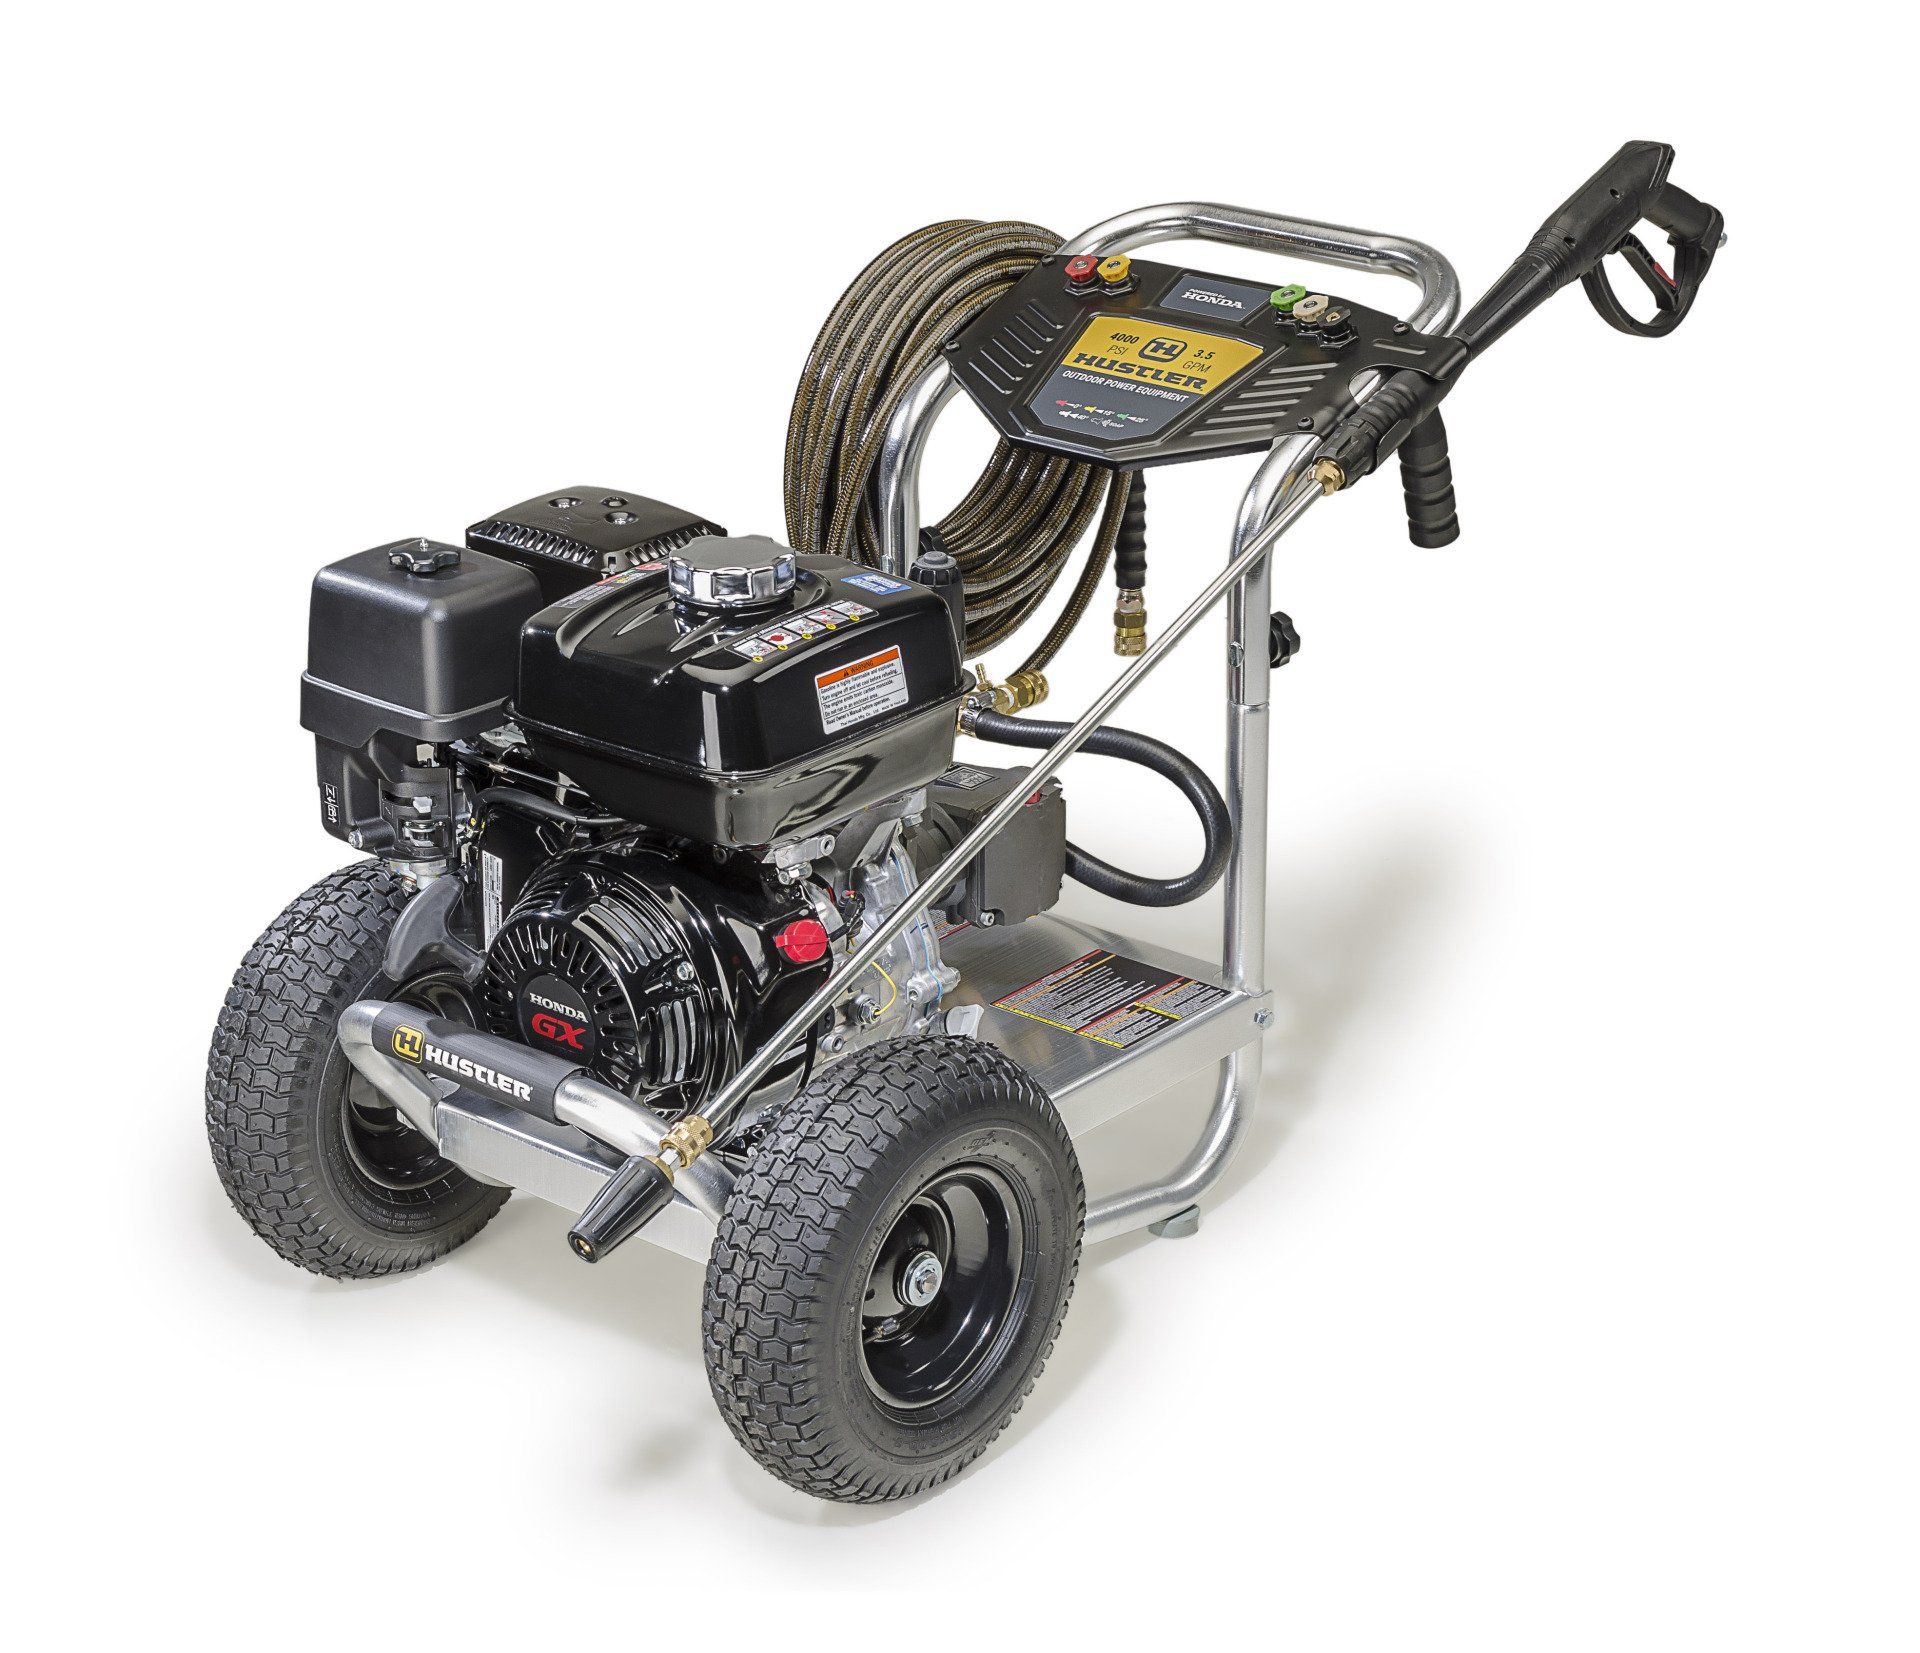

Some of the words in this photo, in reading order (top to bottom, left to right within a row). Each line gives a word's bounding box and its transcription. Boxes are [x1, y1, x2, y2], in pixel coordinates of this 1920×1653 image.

[1181, 291, 1243, 309] HONDA
[1110, 332, 1140, 344] 4000
[1107, 344, 1128, 356] PSI
[1193, 349, 1215, 360] 3.5
[1072, 352, 1208, 389] HUSTLER
[1183, 361, 1211, 373] GPM
[1062, 370, 1106, 386] OUTDOOR
[1104, 379, 1138, 392] POWER
[1135, 385, 1190, 403] EQUIPMENT
[850, 660, 873, 673] WARNING
[820, 684, 835, 694] Gasoline
[830, 690, 842, 698] engine
[869, 674, 881, 682] before
[831, 698, 843, 707] engine
[849, 707, 861, 715] Manual
[529, 992, 589, 1023] HONDA
[531, 1013, 586, 1050] GX
[425, 1043, 531, 1102] HUSTLER
